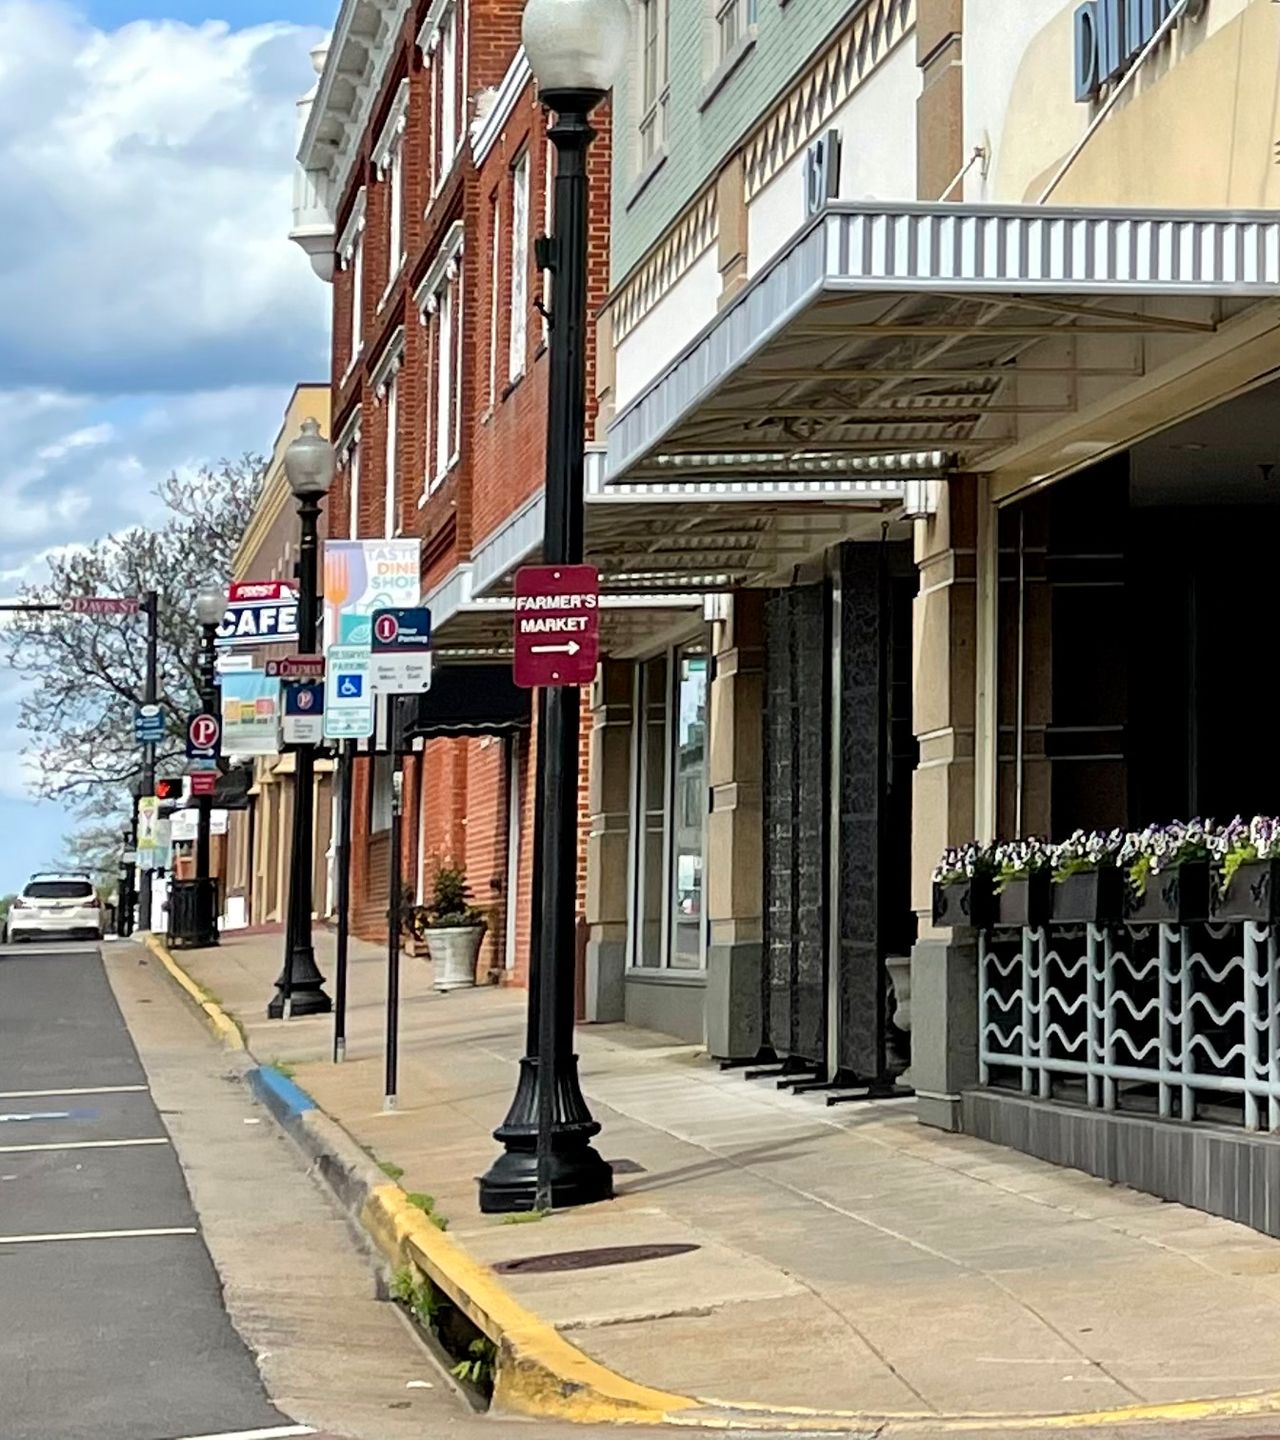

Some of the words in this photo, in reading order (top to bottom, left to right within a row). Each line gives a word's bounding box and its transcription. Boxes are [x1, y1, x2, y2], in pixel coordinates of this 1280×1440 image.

[366, 548, 417, 561] TASTE
[377, 562, 418, 575] DINE
[516, 594, 597, 611] FARMER'S
[215, 606, 298, 637] CAFE
[520, 617, 588, 633] MARKET
[198, 720, 215, 744] P
